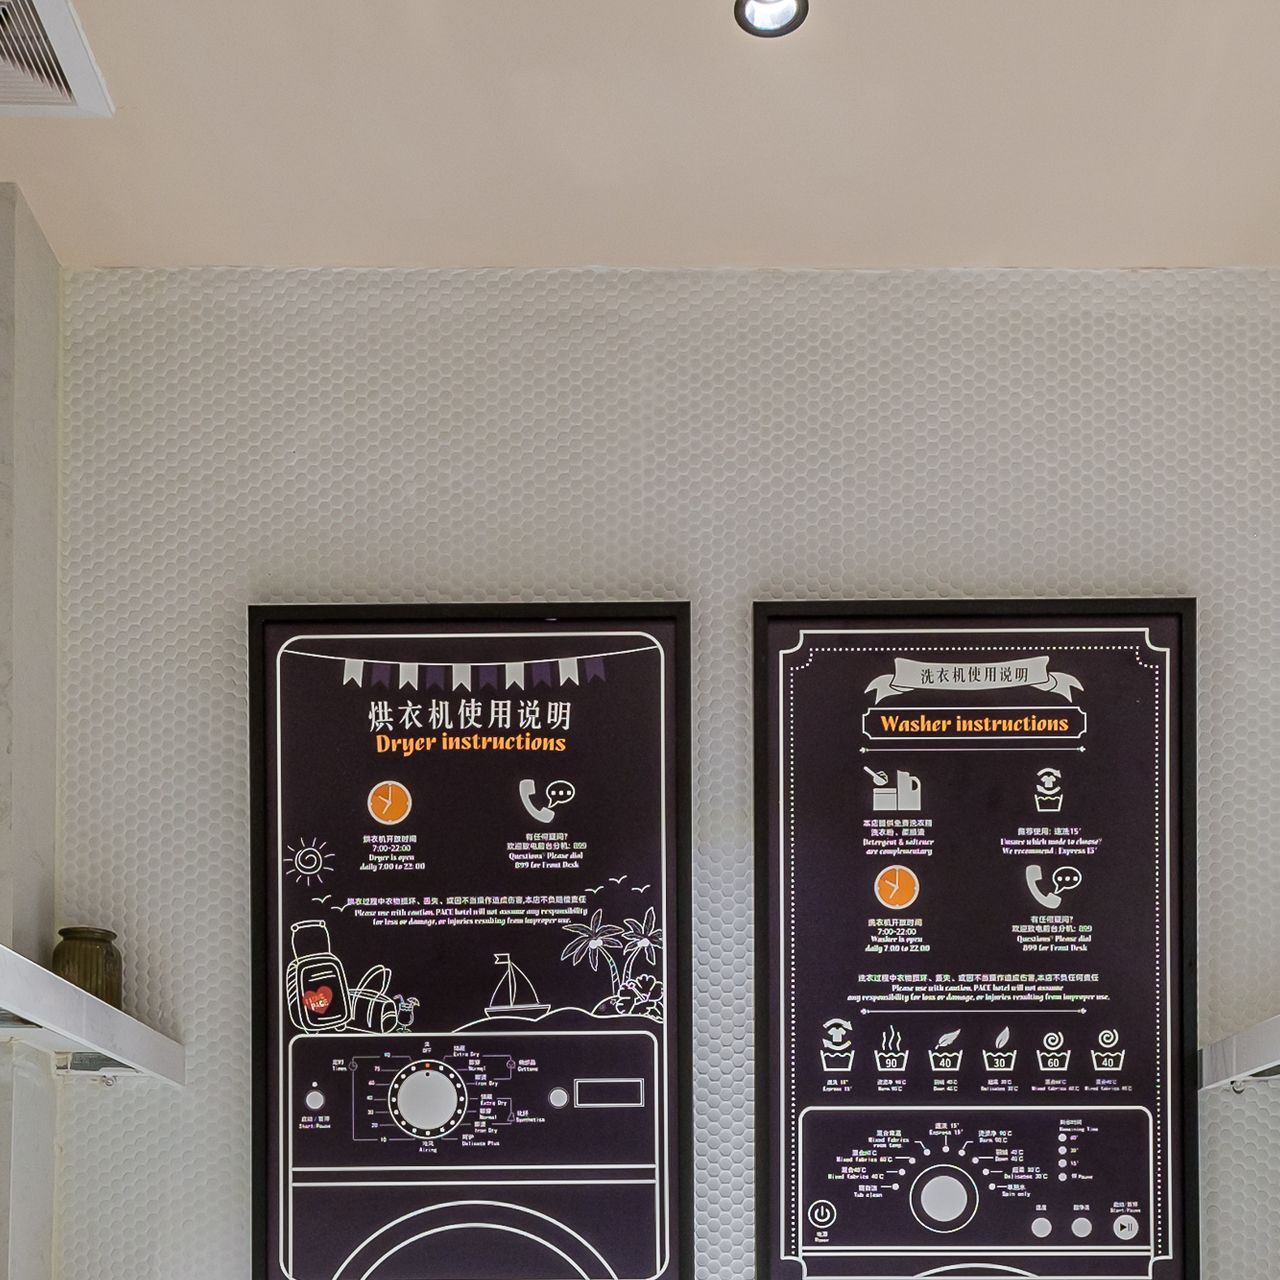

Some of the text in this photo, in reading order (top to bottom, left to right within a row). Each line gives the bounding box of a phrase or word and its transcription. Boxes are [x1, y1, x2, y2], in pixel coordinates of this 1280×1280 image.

[920, 666, 1029, 685] 洗衣机使用说明
[368, 699, 572, 732] 烘衣机使用说明
[880, 713, 1069, 733] Washer instructions
[376, 732, 566, 757] Dryer instructions
[886, 1059, 897, 1067] 90
[940, 1058, 951, 1067] 40
[994, 1059, 1005, 1067] 30
[1048, 1059, 1059, 1067] 60
[1102, 1058, 1113, 1068] 40
